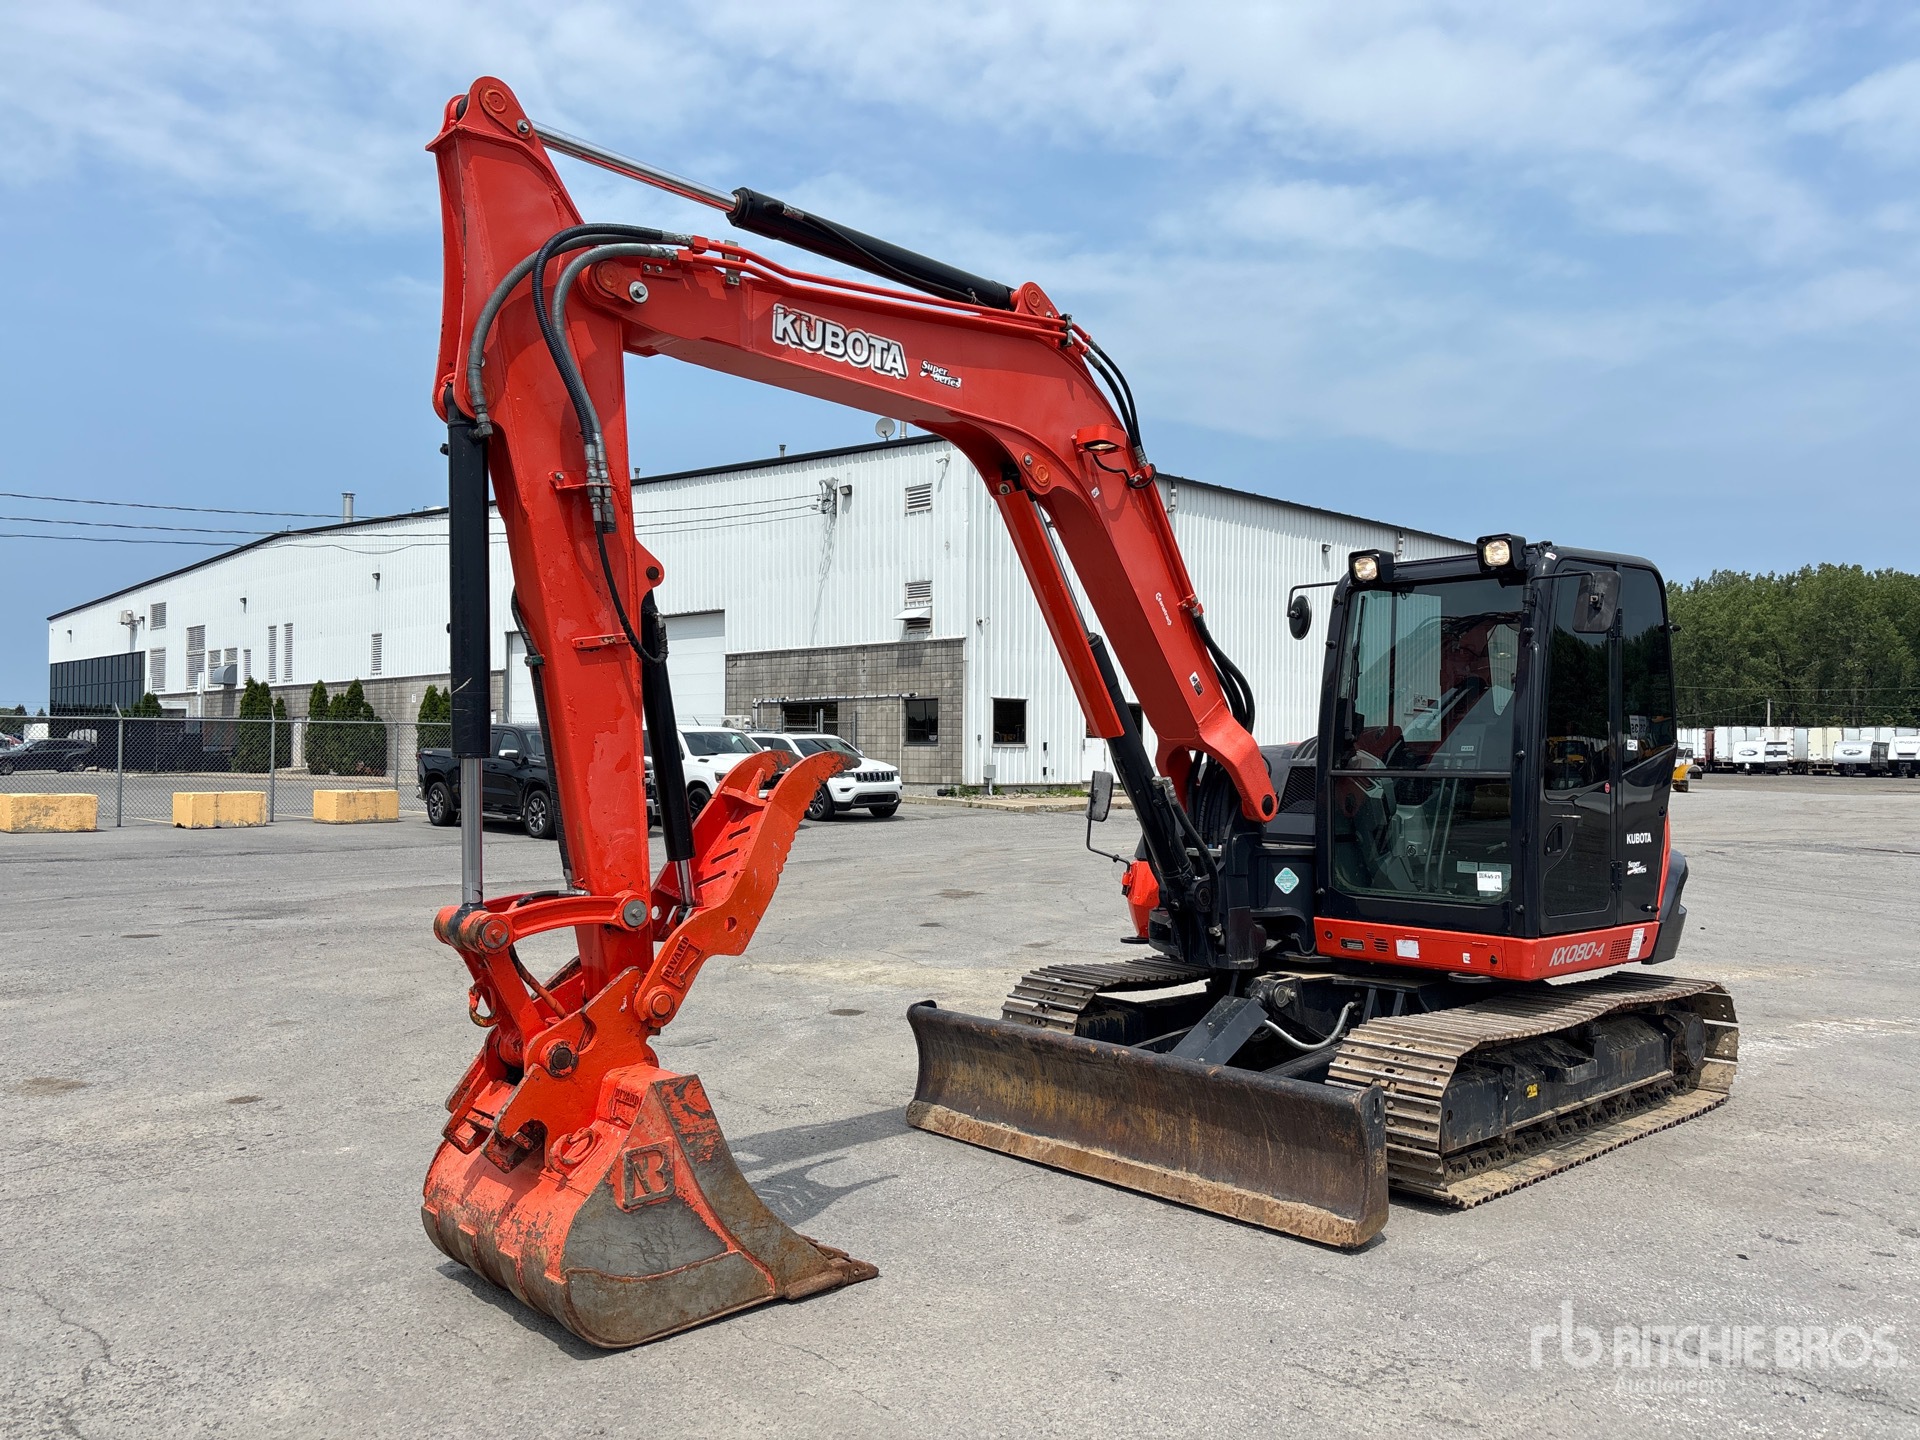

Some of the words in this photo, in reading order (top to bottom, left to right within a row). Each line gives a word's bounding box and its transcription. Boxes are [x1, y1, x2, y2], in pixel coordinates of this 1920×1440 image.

[773, 303, 908, 378] KUBOTA
[921, 360, 949, 376] Super
[1626, 832, 1652, 845] KUBOTA
[662, 936, 690, 979] RIVARD
[1548, 941, 1606, 967] KX080-4
